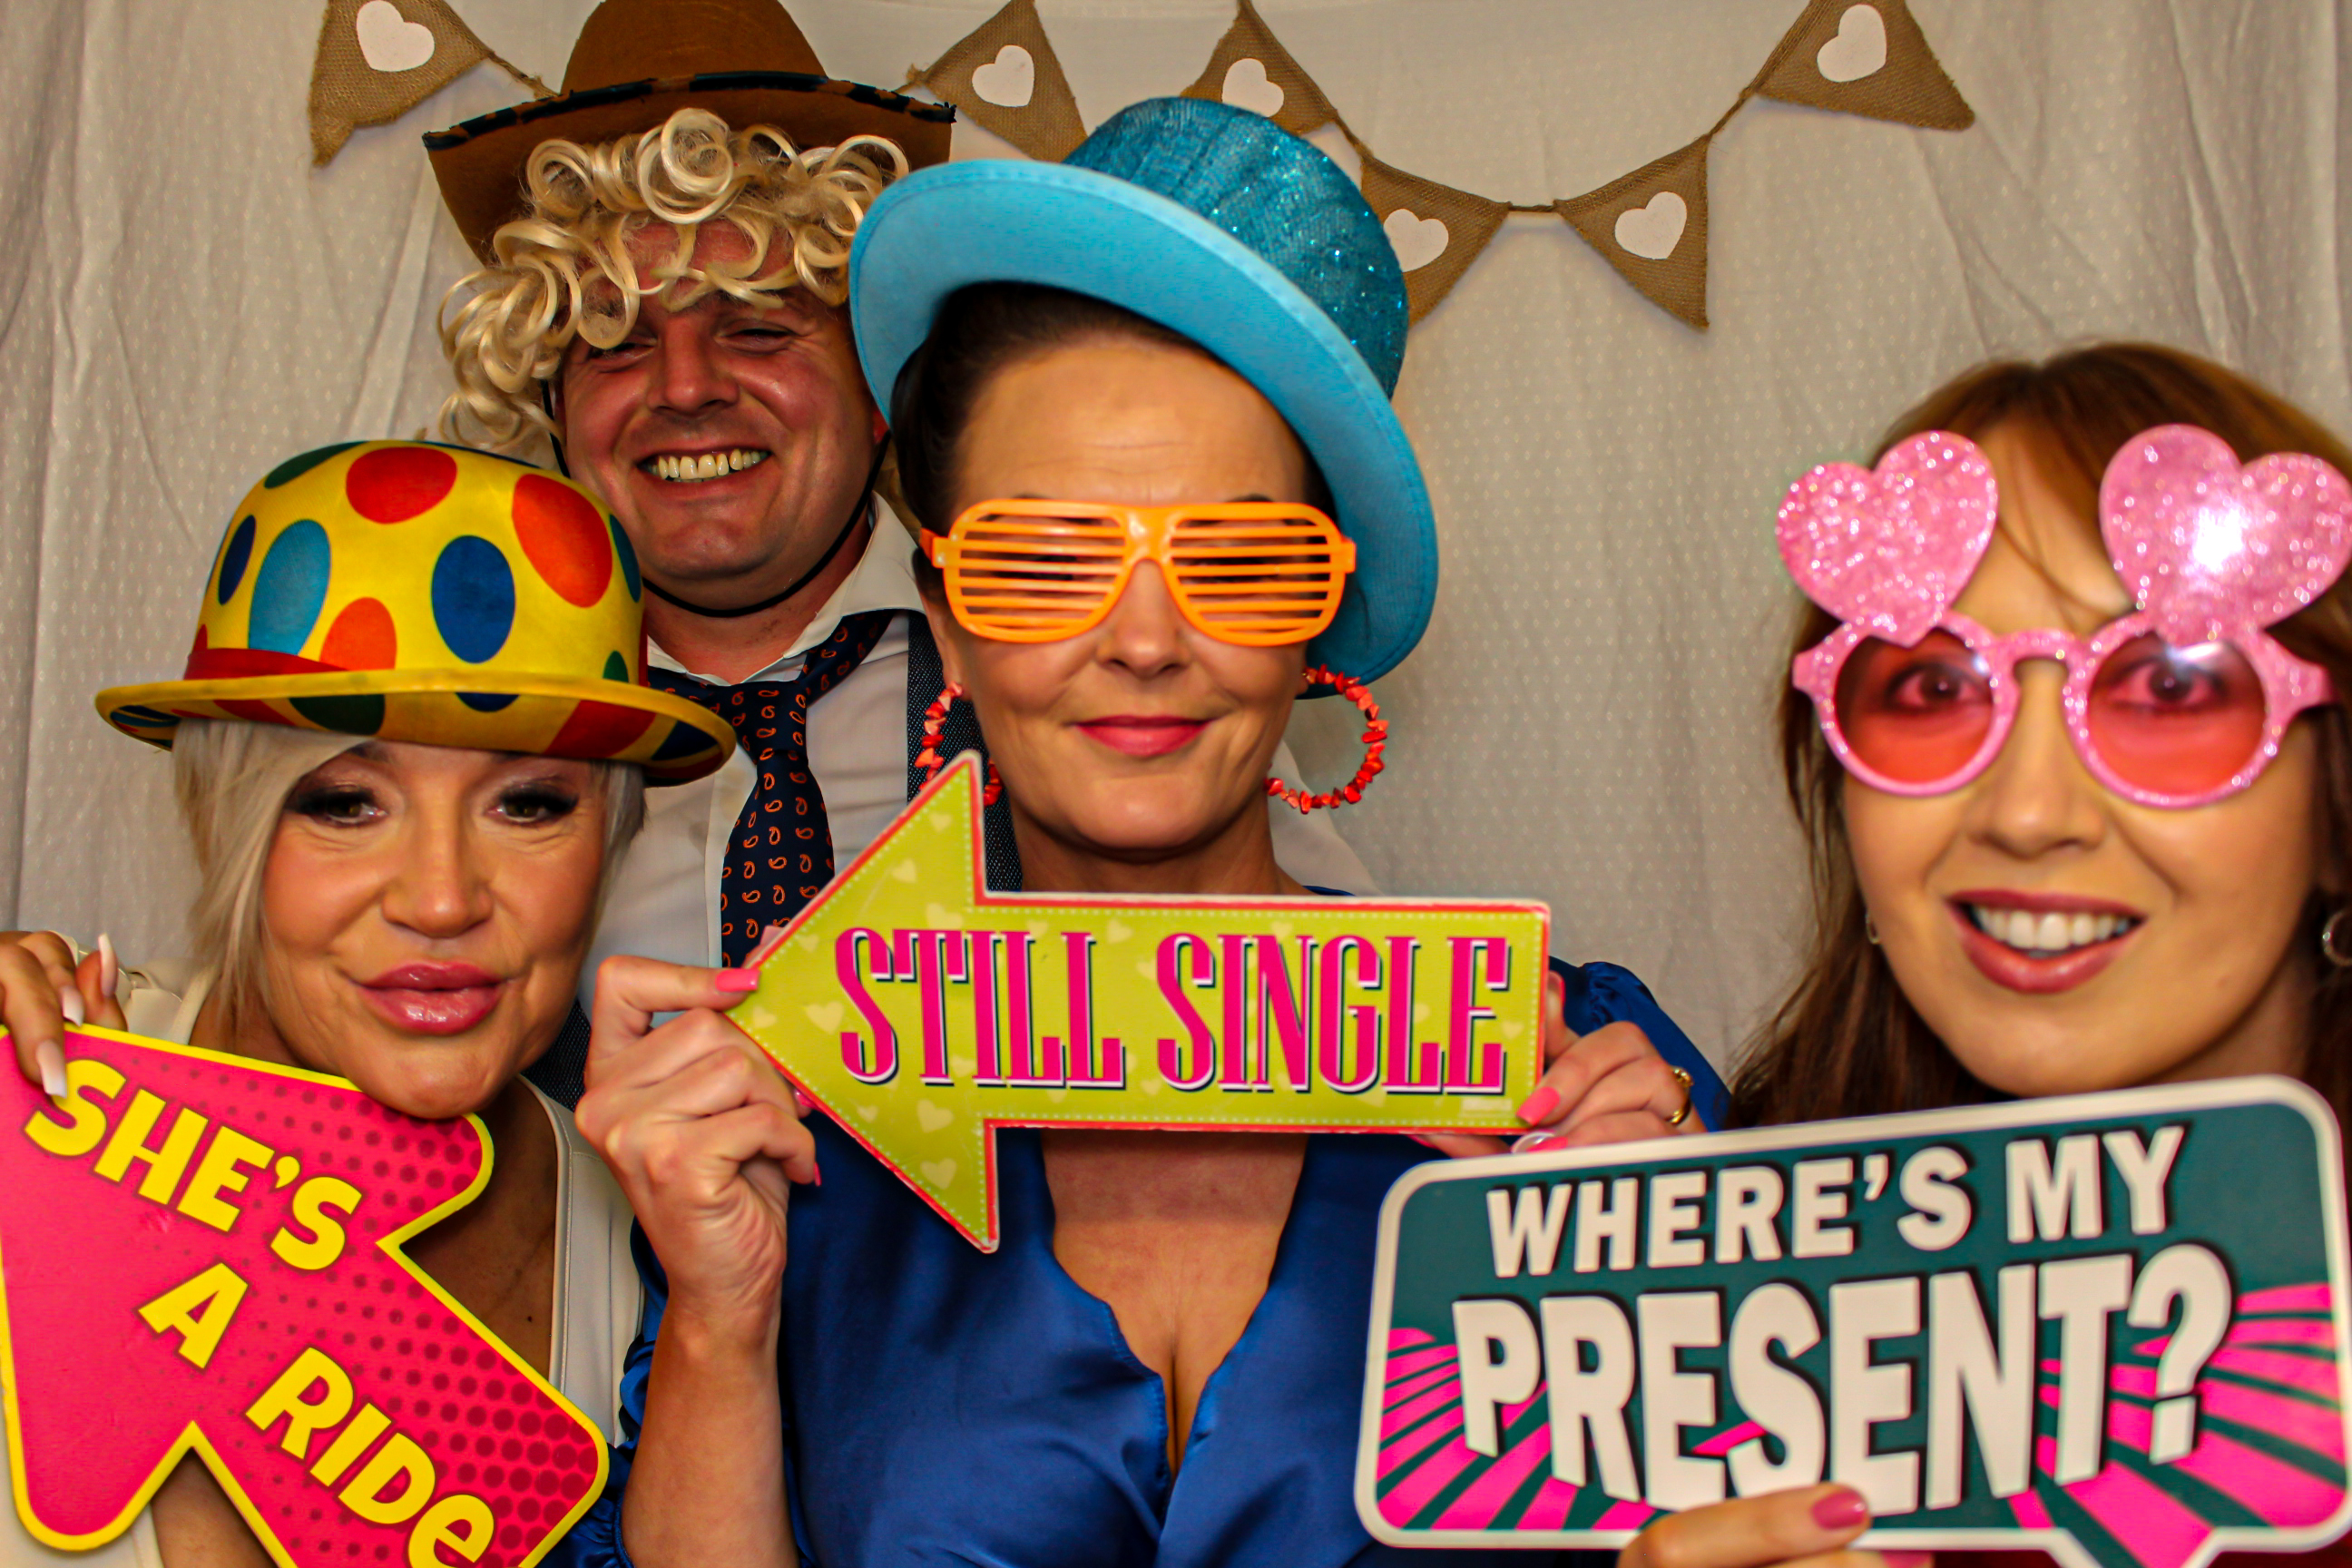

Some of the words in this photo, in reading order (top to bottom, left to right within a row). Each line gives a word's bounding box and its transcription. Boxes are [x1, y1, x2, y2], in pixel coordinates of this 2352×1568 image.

[835, 927, 1126, 1089] STILL
[1157, 933, 1511, 1093] SINGLE
[24, 1059, 363, 1271] SHE'S
[1486, 1148, 1974, 1278] WHERE'S
[2005, 1126, 2186, 1243] MY
[138, 1262, 250, 1369] A
[1452, 1244, 2232, 1515] PRESENT?
